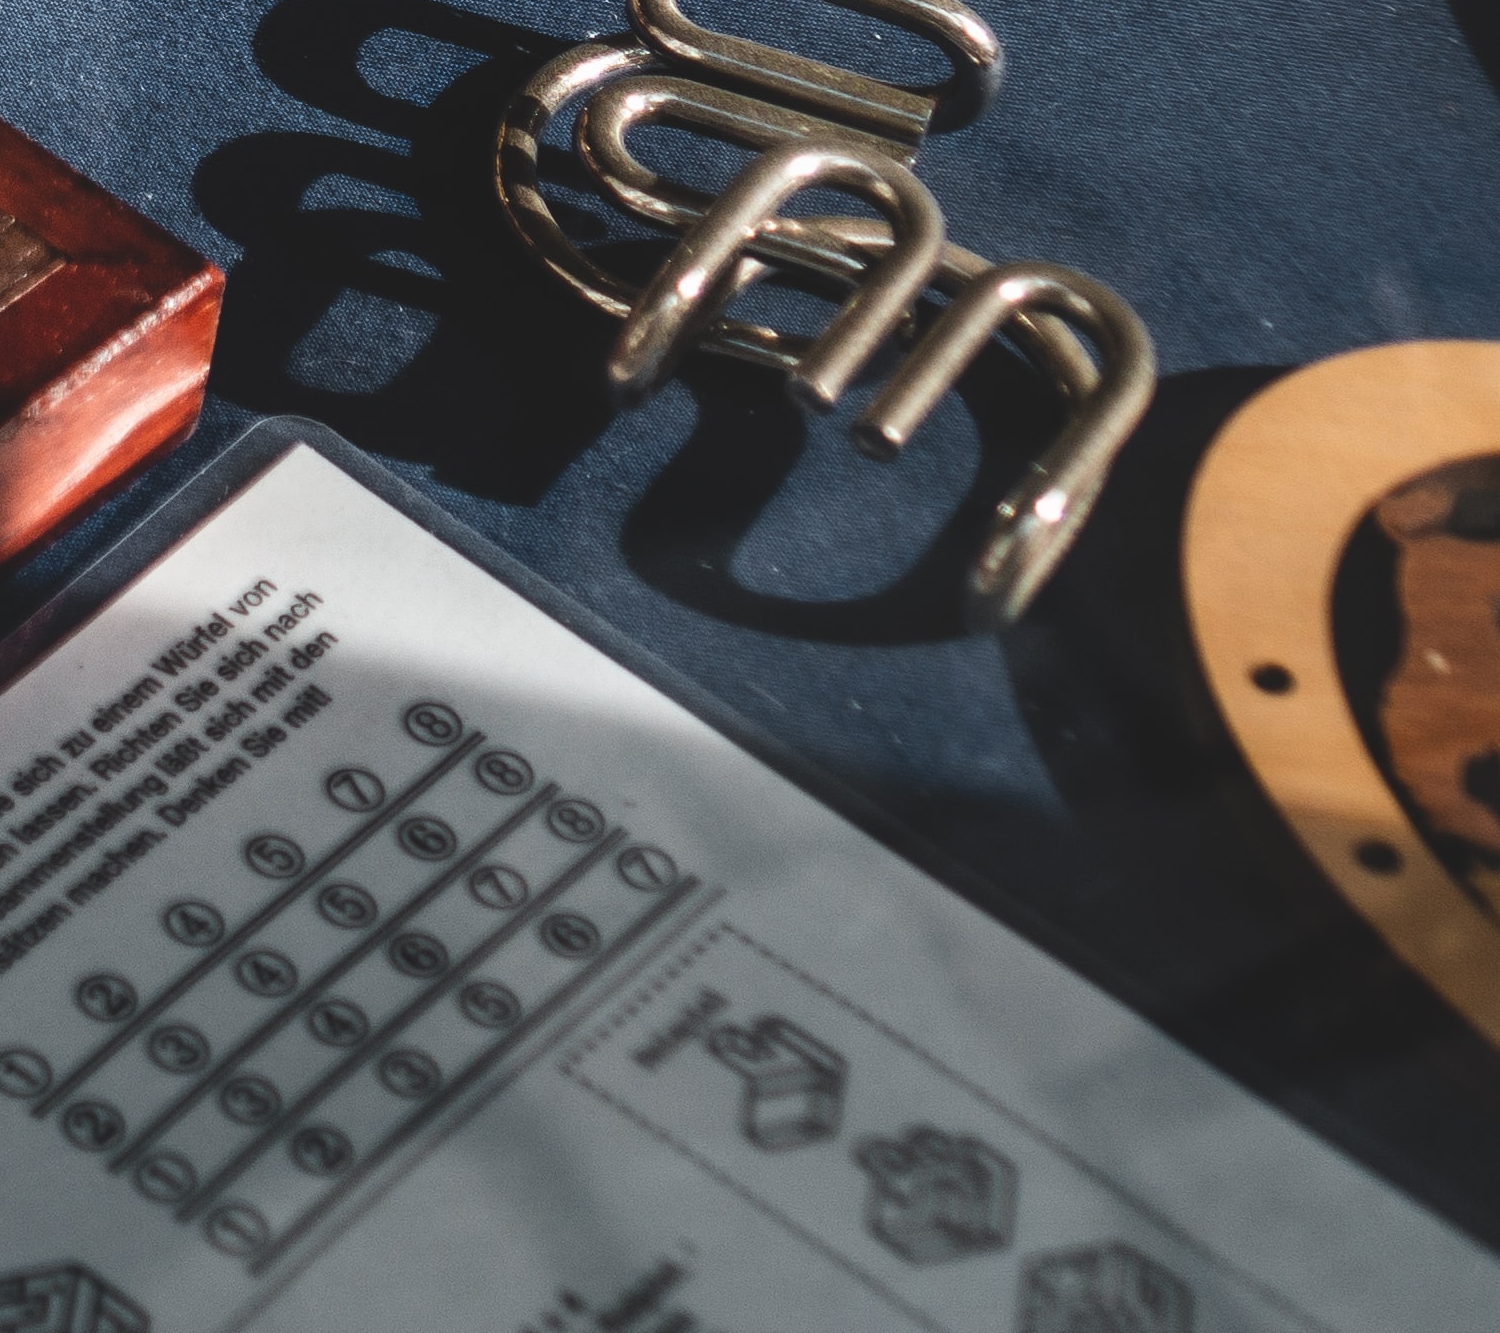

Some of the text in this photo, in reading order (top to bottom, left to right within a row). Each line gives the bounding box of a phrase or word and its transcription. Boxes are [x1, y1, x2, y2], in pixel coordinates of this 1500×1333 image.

[9, 754, 66, 796] sich
[58, 728, 96, 759] zu
[89, 674, 163, 733] einem
[149, 611, 234, 676] Würfel
[228, 578, 277, 616] von
[87, 710, 182, 781] Richten
[172, 678, 219, 712] Sie
[214, 637, 269, 681] sich
[261, 592, 322, 642] nach
[203, 699, 256, 742] sich
[249, 662, 295, 703] mit
[286, 631, 337, 670] den
[154, 755, 251, 828] Denken
[239, 723, 287, 758] Sie
